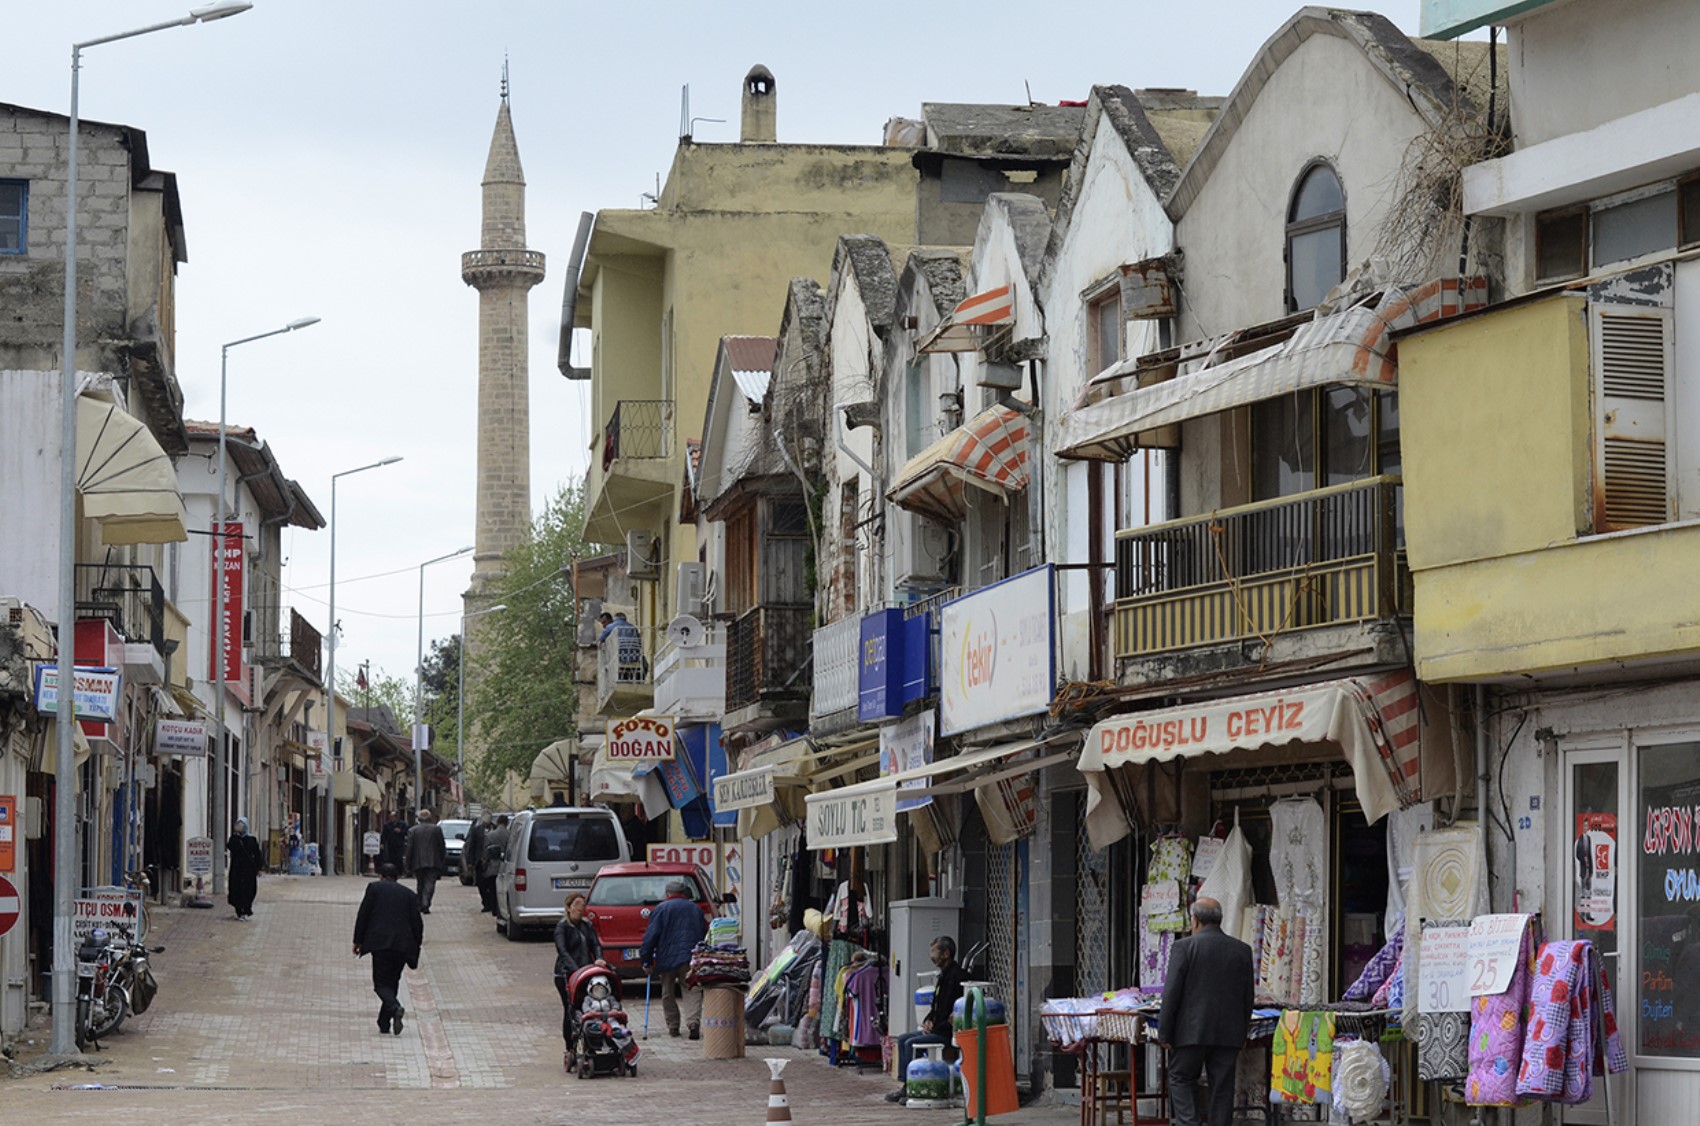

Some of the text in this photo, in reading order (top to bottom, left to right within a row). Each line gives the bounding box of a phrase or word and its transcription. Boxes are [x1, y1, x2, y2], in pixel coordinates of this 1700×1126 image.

[213, 562, 240, 570] KZAN
[966, 630, 992, 688] tekir
[612, 718, 669, 740] FOTO
[1101, 698, 1305, 754] DOĞUŞLU ÇEYİZ
[610, 739, 671, 757] DOĞAN
[818, 801, 847, 837] SOYLU
[651, 848, 713, 866] FOTO
[1470, 958, 1498, 991] 25
[1429, 981, 1449, 1009] 30
